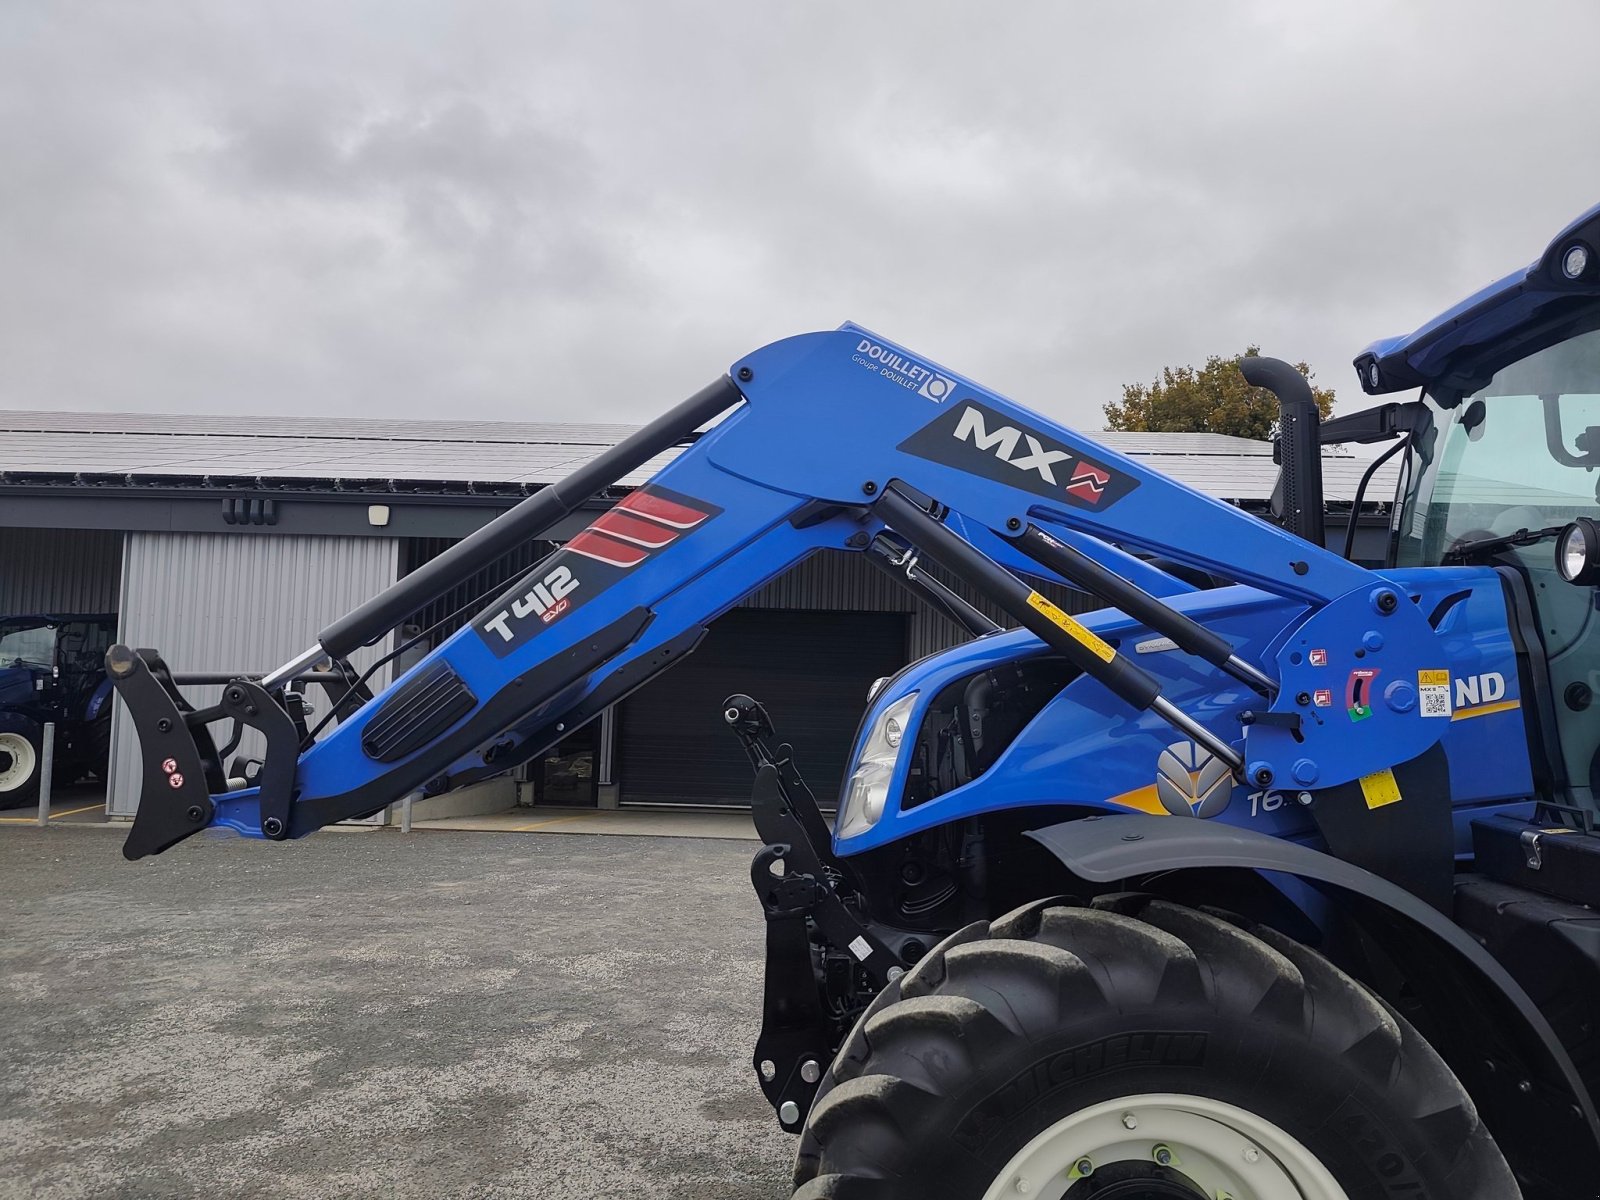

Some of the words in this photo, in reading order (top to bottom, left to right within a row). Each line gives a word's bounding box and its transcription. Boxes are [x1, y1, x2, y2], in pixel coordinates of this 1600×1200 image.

[851, 353, 879, 372] Groupe
[880, 368, 919, 391] DOUILLET
[856, 339, 930, 382] DOUILLET
[953, 405, 1073, 486] MX
[543, 599, 567, 623] EVO
[998, 1032, 1206, 1118] MICHELIN
